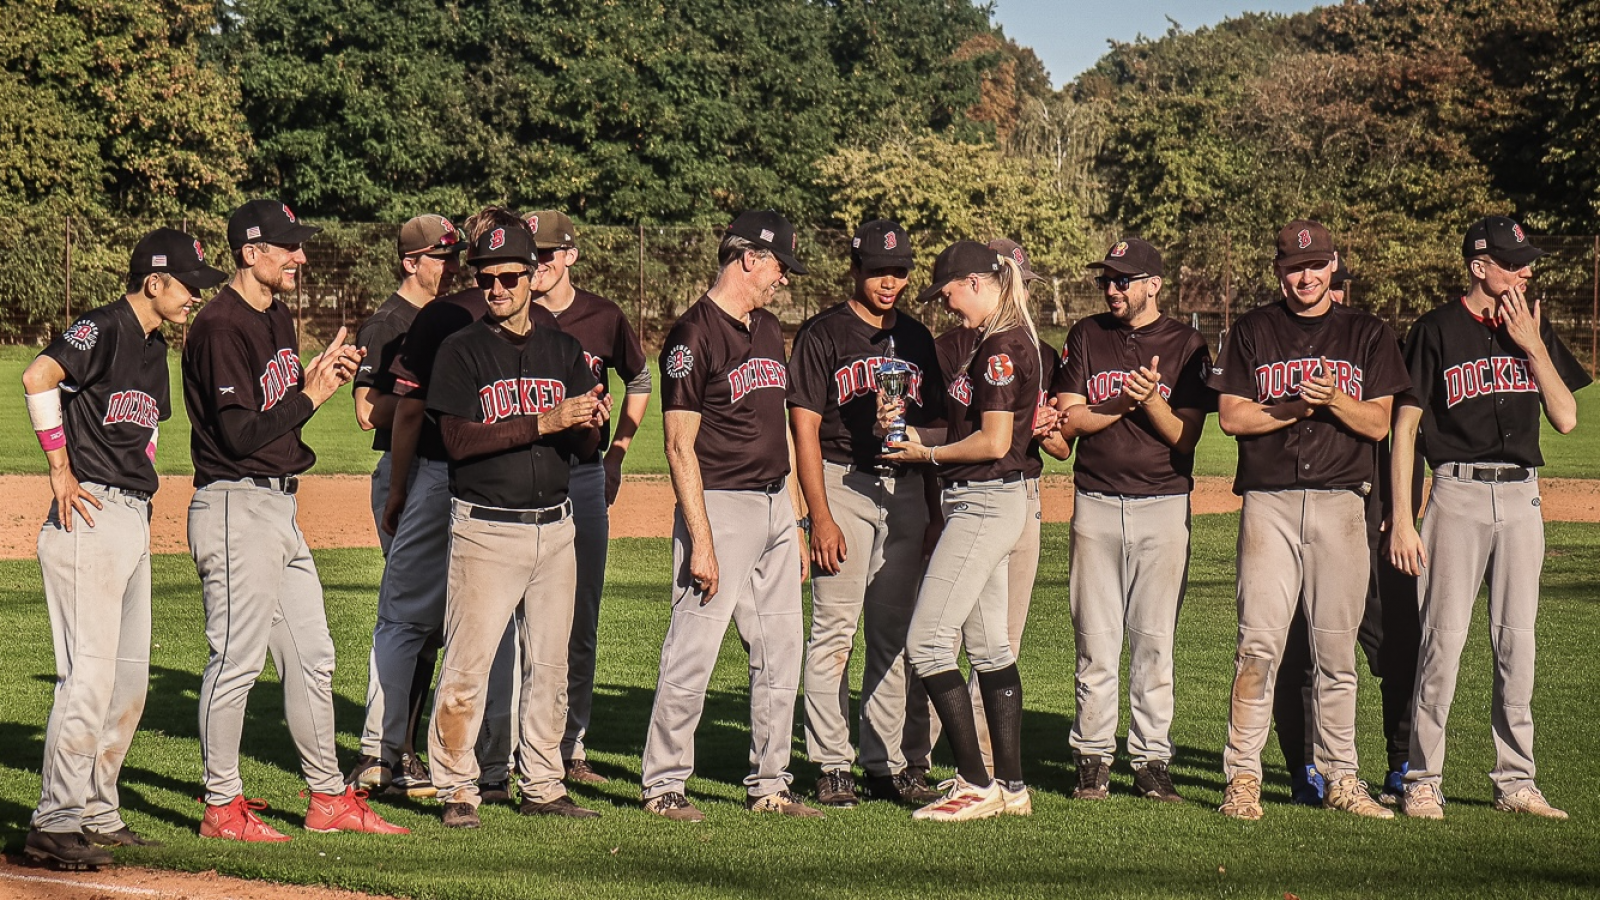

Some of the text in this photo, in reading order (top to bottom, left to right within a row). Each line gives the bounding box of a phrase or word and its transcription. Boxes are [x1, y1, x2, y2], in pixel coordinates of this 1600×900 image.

[489, 227, 506, 250] B
[884, 230, 897, 250] B
[1297, 228, 1312, 249] B
